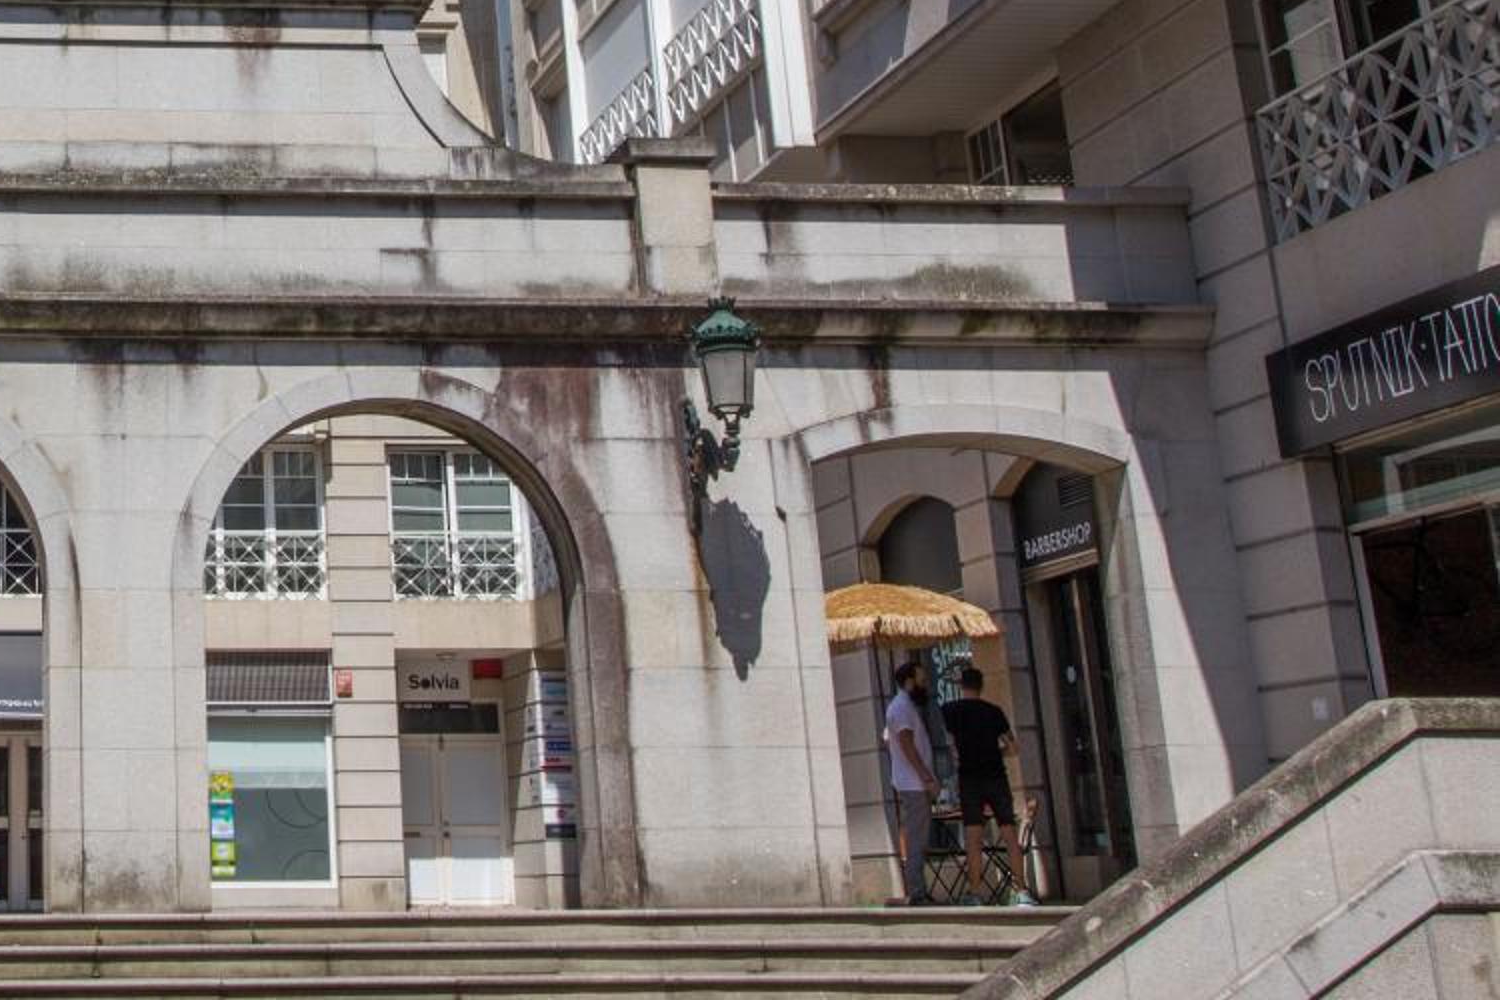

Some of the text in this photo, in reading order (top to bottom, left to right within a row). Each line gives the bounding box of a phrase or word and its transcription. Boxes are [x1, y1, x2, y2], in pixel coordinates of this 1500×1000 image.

[1304, 319, 1428, 422] SPUTNIK
[1024, 521, 1091, 560] BARBERSHOP
[408, 672, 460, 690] Solvia
